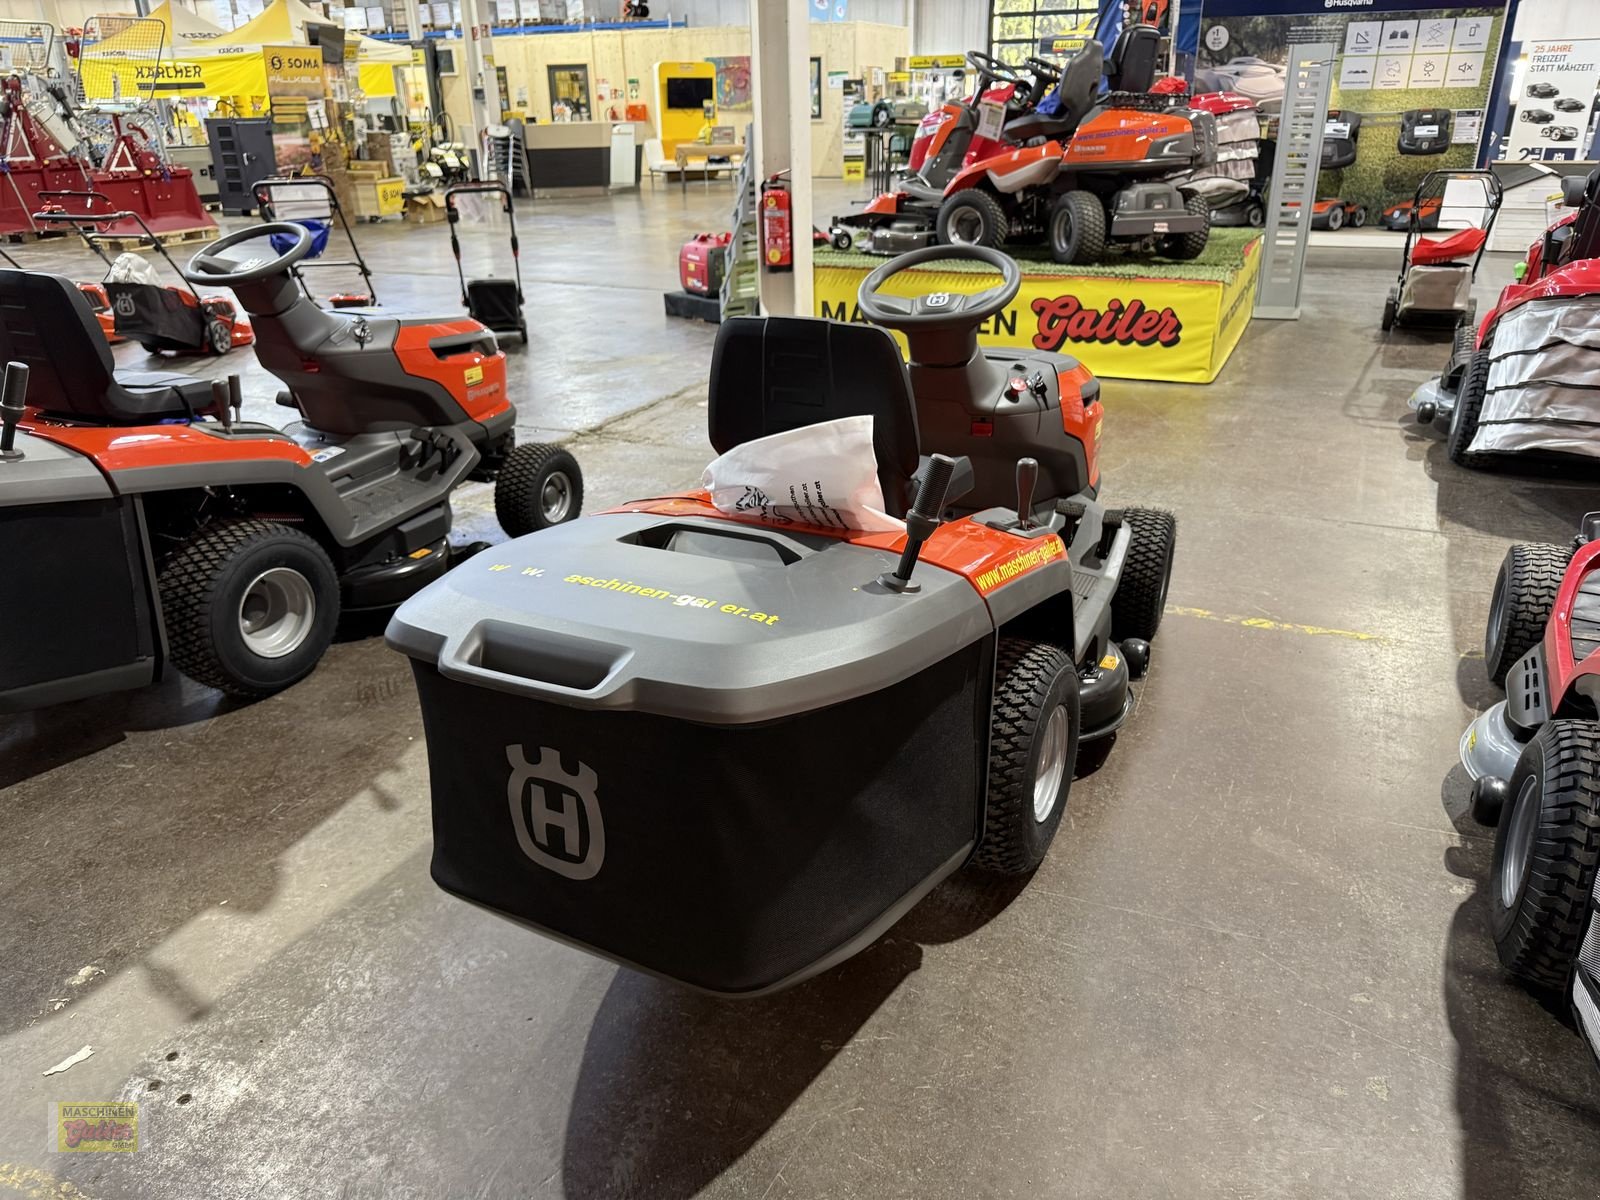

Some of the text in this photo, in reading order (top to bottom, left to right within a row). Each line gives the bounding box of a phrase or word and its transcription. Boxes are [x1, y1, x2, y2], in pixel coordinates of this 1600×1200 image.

[1534, 44, 1574, 53] 25 JAHRE
[288, 57, 320, 69] SOMA
[1532, 55, 1567, 63] FREIZEIT
[1530, 64, 1556, 72] STATT
[1031, 295, 1183, 352] Gailer
